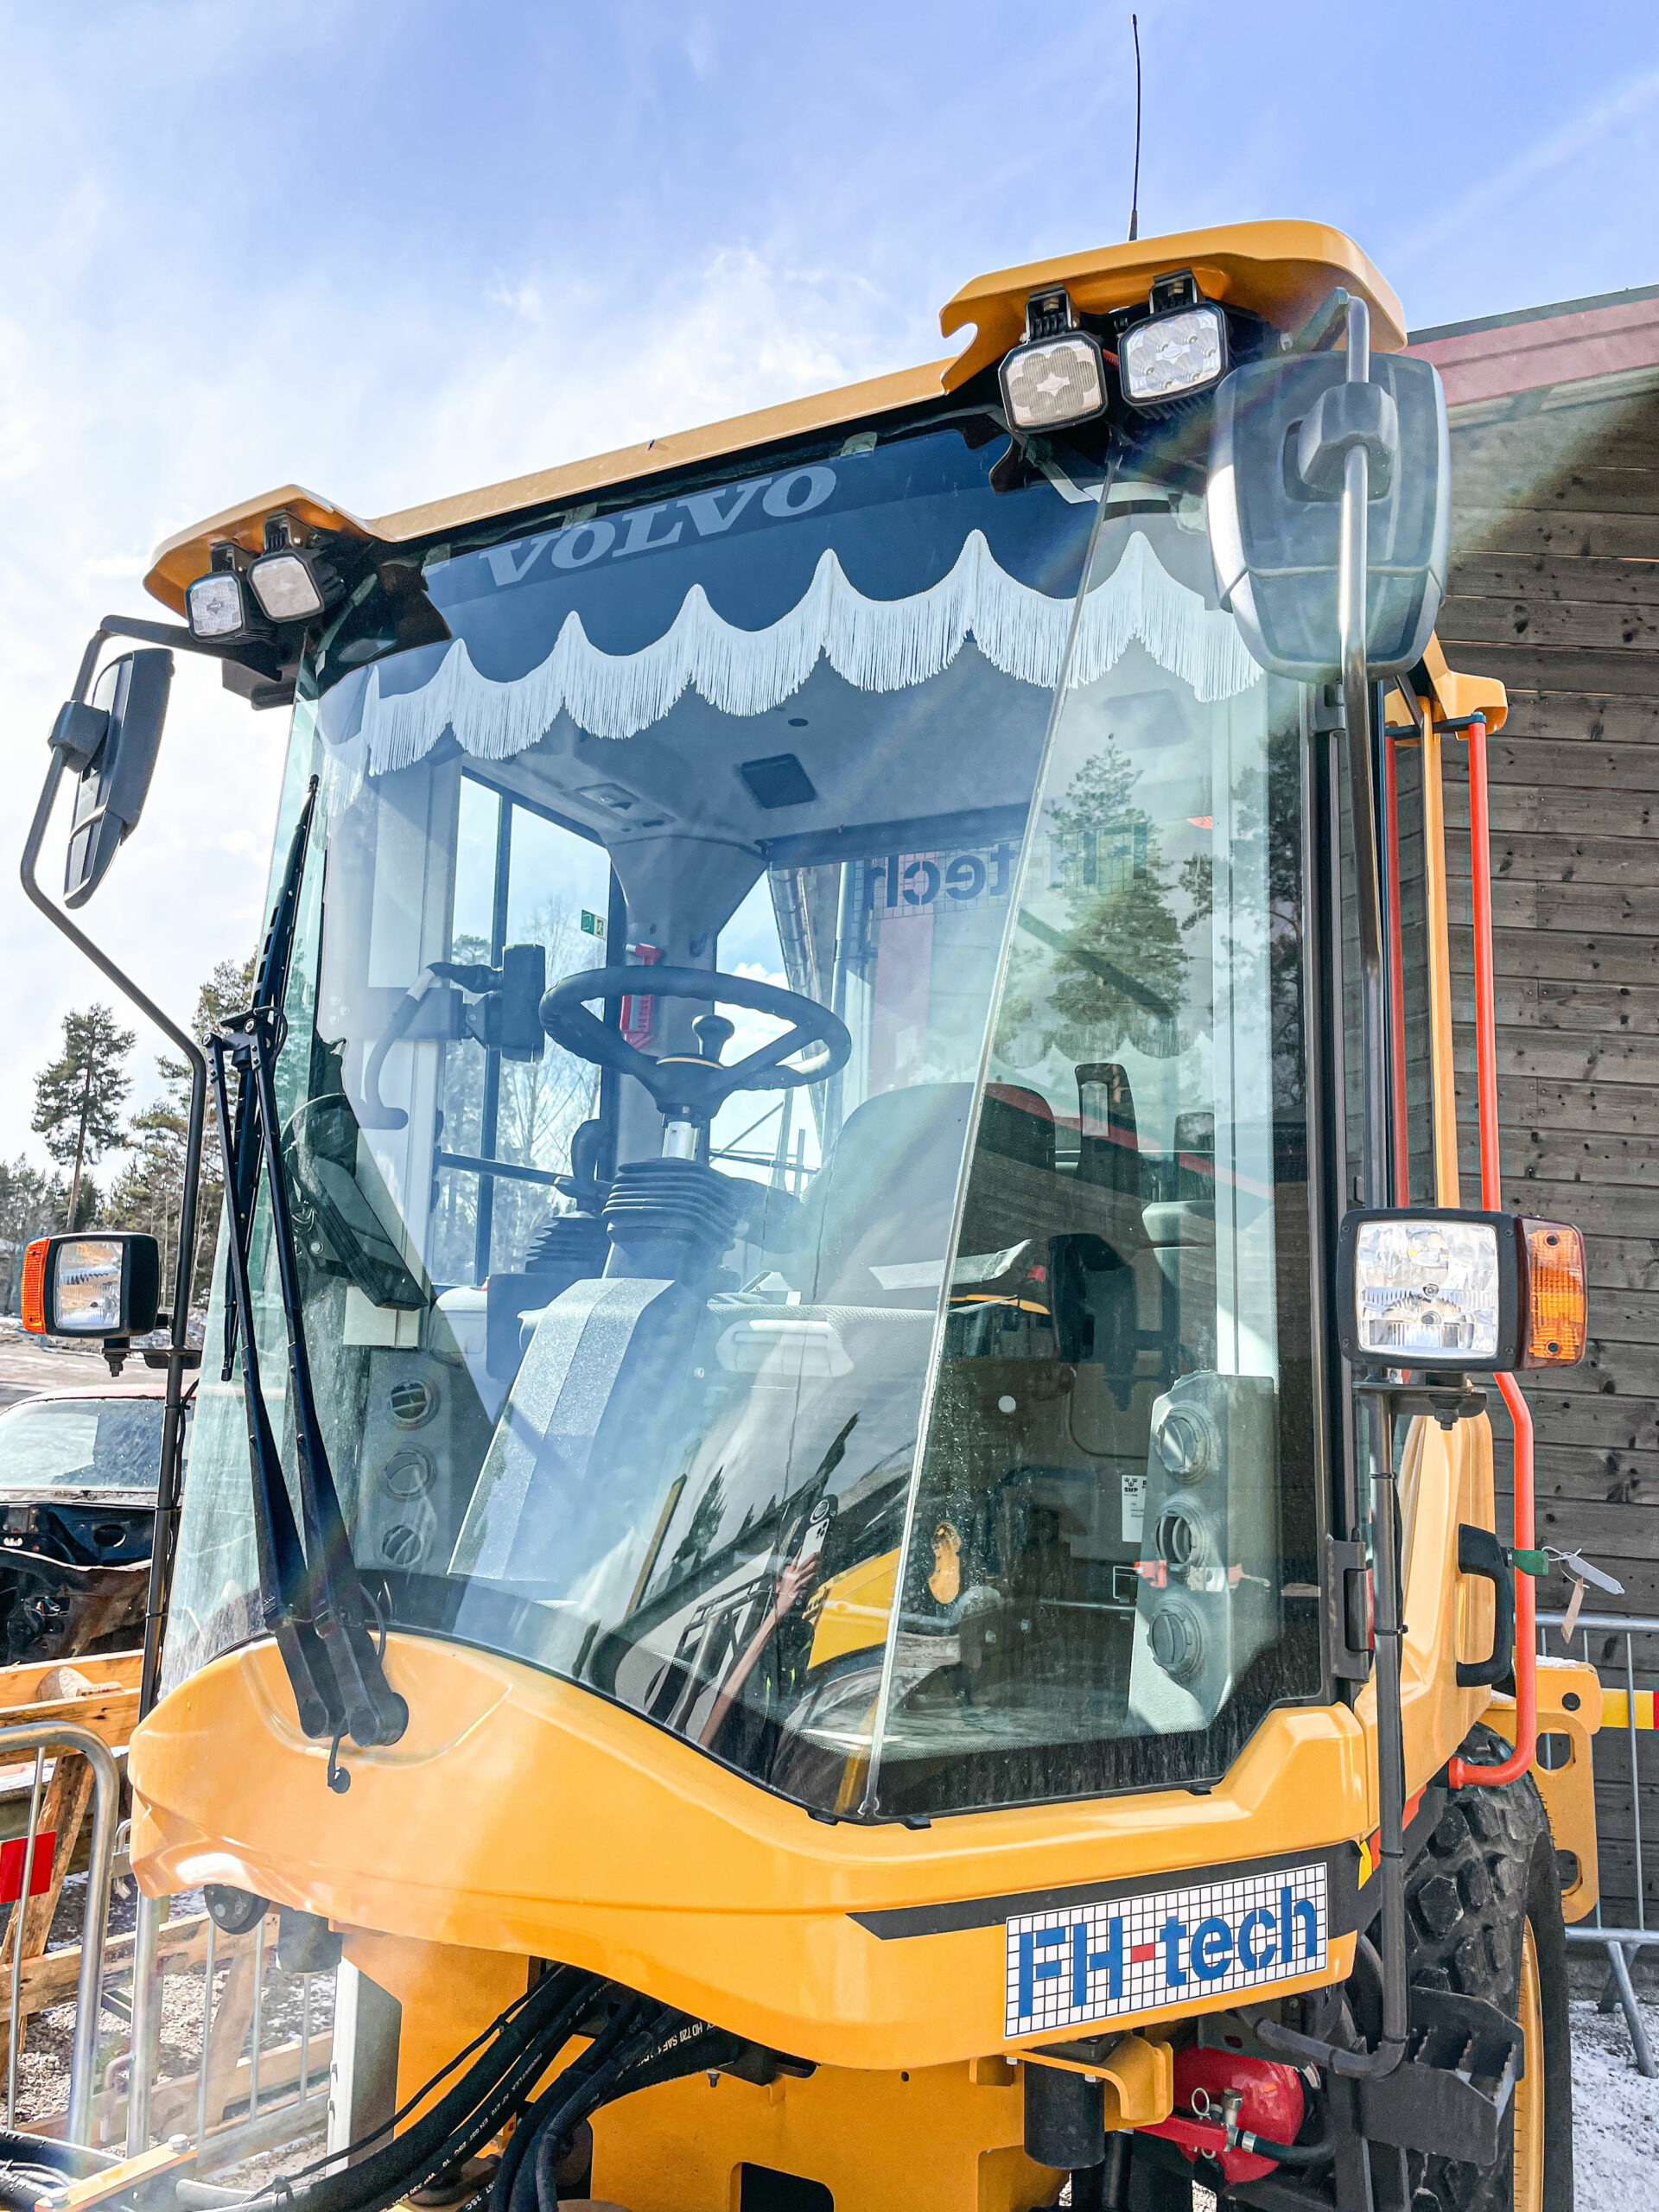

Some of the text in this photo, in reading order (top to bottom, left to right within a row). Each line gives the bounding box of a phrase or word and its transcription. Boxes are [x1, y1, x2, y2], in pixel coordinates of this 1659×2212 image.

[479, 466, 837, 587] VOLVO
[1018, 1886, 1318, 2018] FH-tech
[679, 2028, 691, 2042] 720
[692, 2021, 702, 2037] HD
[465, 2194, 481, 2209] 2SC
